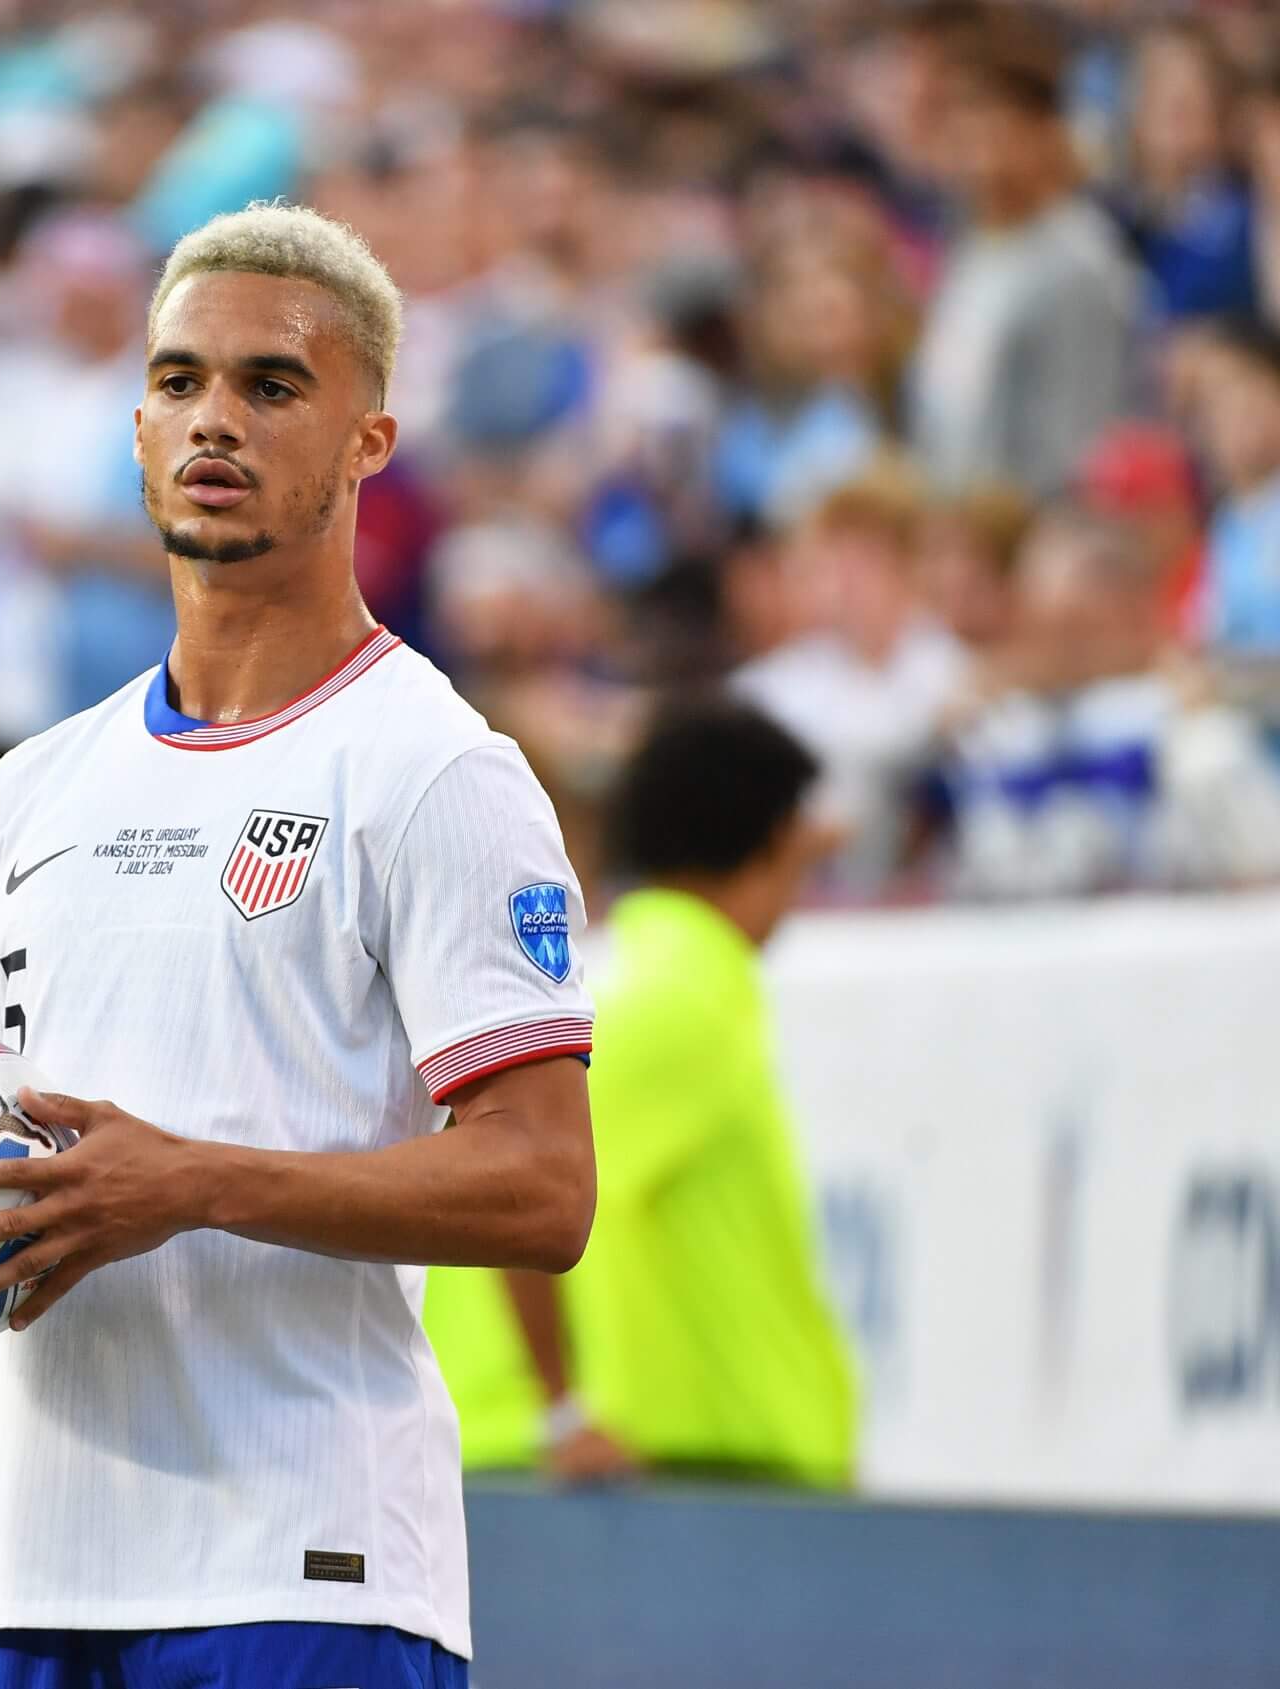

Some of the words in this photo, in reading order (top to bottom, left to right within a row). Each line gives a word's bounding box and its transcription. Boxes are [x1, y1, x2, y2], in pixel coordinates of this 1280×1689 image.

[116, 829, 138, 842] USA
[140, 829, 155, 842] VS.
[155, 827, 201, 841] URUGUAY
[246, 816, 320, 858] USA
[92, 844, 137, 858] KANSAS
[163, 845, 209, 858] MISSOURI
[115, 860, 122, 874] 1
[122, 860, 149, 875] JULY
[148, 860, 175, 875] 2024
[522, 926, 538, 934] THE
[0, 947, 27, 1056] 5
